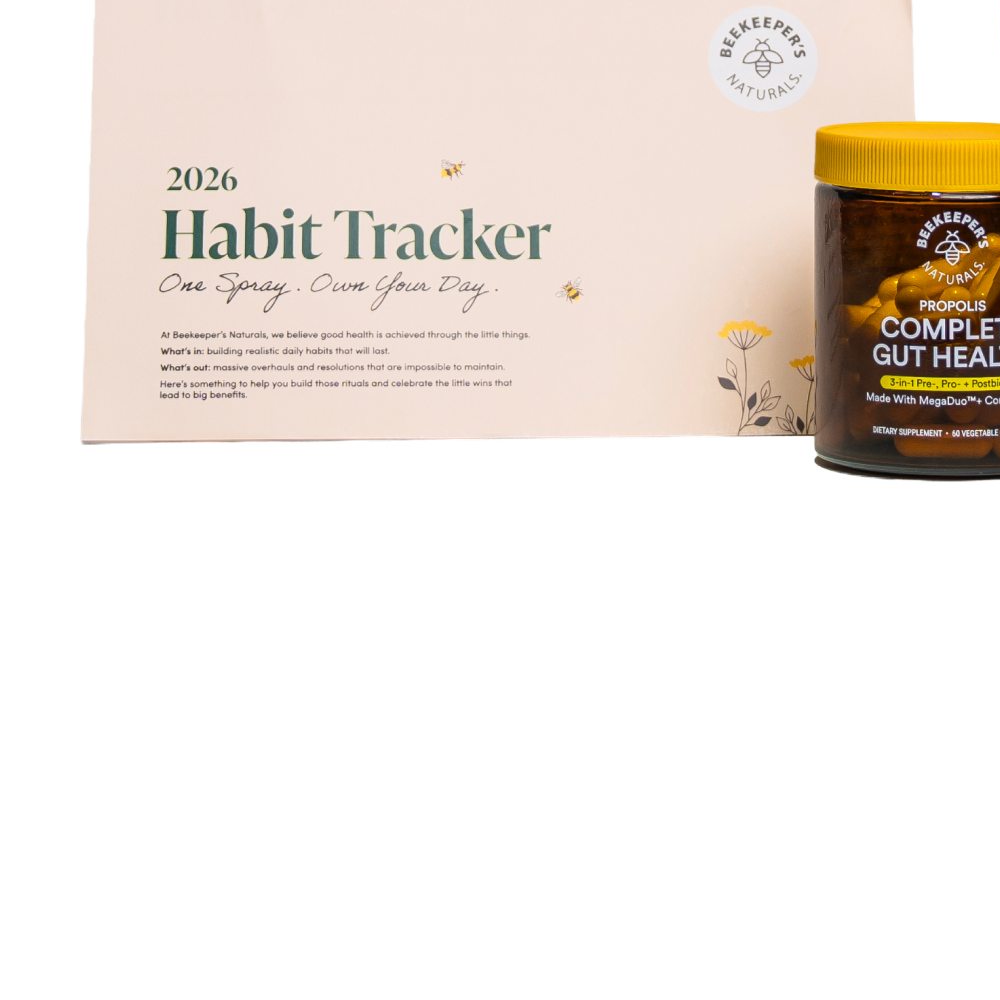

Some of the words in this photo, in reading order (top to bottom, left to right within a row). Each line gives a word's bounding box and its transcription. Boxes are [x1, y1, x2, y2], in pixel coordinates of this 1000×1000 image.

[719, 16, 807, 58] BEEKEEPER'S
[166, 166, 238, 191] 2026
[161, 206, 323, 260] Habit
[333, 207, 552, 260] Tracker
[916, 211, 989, 250] BEEKEEPER'S
[158, 272, 207, 293] One
[310, 272, 370, 293] Own
[370, 271, 431, 312] Your
[919, 300, 987, 312] PROPOLIS
[160, 331, 171, 339] At
[173, 330, 227, 341] Beekeeper's
[229, 331, 269, 340] Naturals,
[286, 330, 318, 339] believe
[320, 330, 344, 341] good
[346, 330, 374, 339] health
[376, 331, 383, 339] is
[385, 330, 425, 339] achieved
[427, 330, 462, 341] through
[465, 330, 479, 339] the
[481, 330, 499, 339] little
[501, 330, 530, 341] things.
[160, 347, 192, 356] What's
[193, 347, 205, 355] in:
[206, 347, 243, 357] building
[245, 346, 280, 355] realistic
[282, 346, 304, 357] daily
[305, 346, 333, 355] habits
[335, 346, 353, 355] that
[355, 346, 370, 355] will
[372, 347, 390, 355] last.
[872, 343, 926, 368] GUT
[160, 363, 191, 372] What's
[192, 364, 211, 372] out:
[212, 364, 249, 372] massive
[251, 363, 295, 371] overhauls
[296, 363, 315, 371] and
[316, 363, 365, 371] resolutions
[367, 363, 385, 371] that
[404, 363, 451, 373] impossible
[464, 363, 506, 371] maintain.
[160, 380, 188, 388] Here's
[190, 380, 237, 389] something
[239, 380, 248, 388] to
[250, 380, 270, 390] help
[272, 381, 289, 390] you
[291, 380, 313, 388] build
[315, 380, 340, 388] those
[341, 379, 370, 388] rituals
[371, 379, 389, 388] and
[391, 379, 433, 388] celebrate
[435, 379, 450, 387] the
[451, 379, 471, 387] little
[472, 379, 493, 387] wins
[494, 379, 513, 387] that
[890, 378, 914, 388] 3-in-1
[941, 379, 961, 389] Pro-
[159, 390, 180, 399] lead
[182, 391, 191, 399] to
[193, 390, 208, 401] big
[210, 390, 248, 399] benefits.
[866, 392, 891, 403] Made
[893, 393, 917, 405] With
[872, 425, 898, 435] DIETARY
[898, 427, 943, 437] SUPPLEMENT
[952, 429, 961, 437] 60
[961, 429, 999, 437] VEGETABLE
